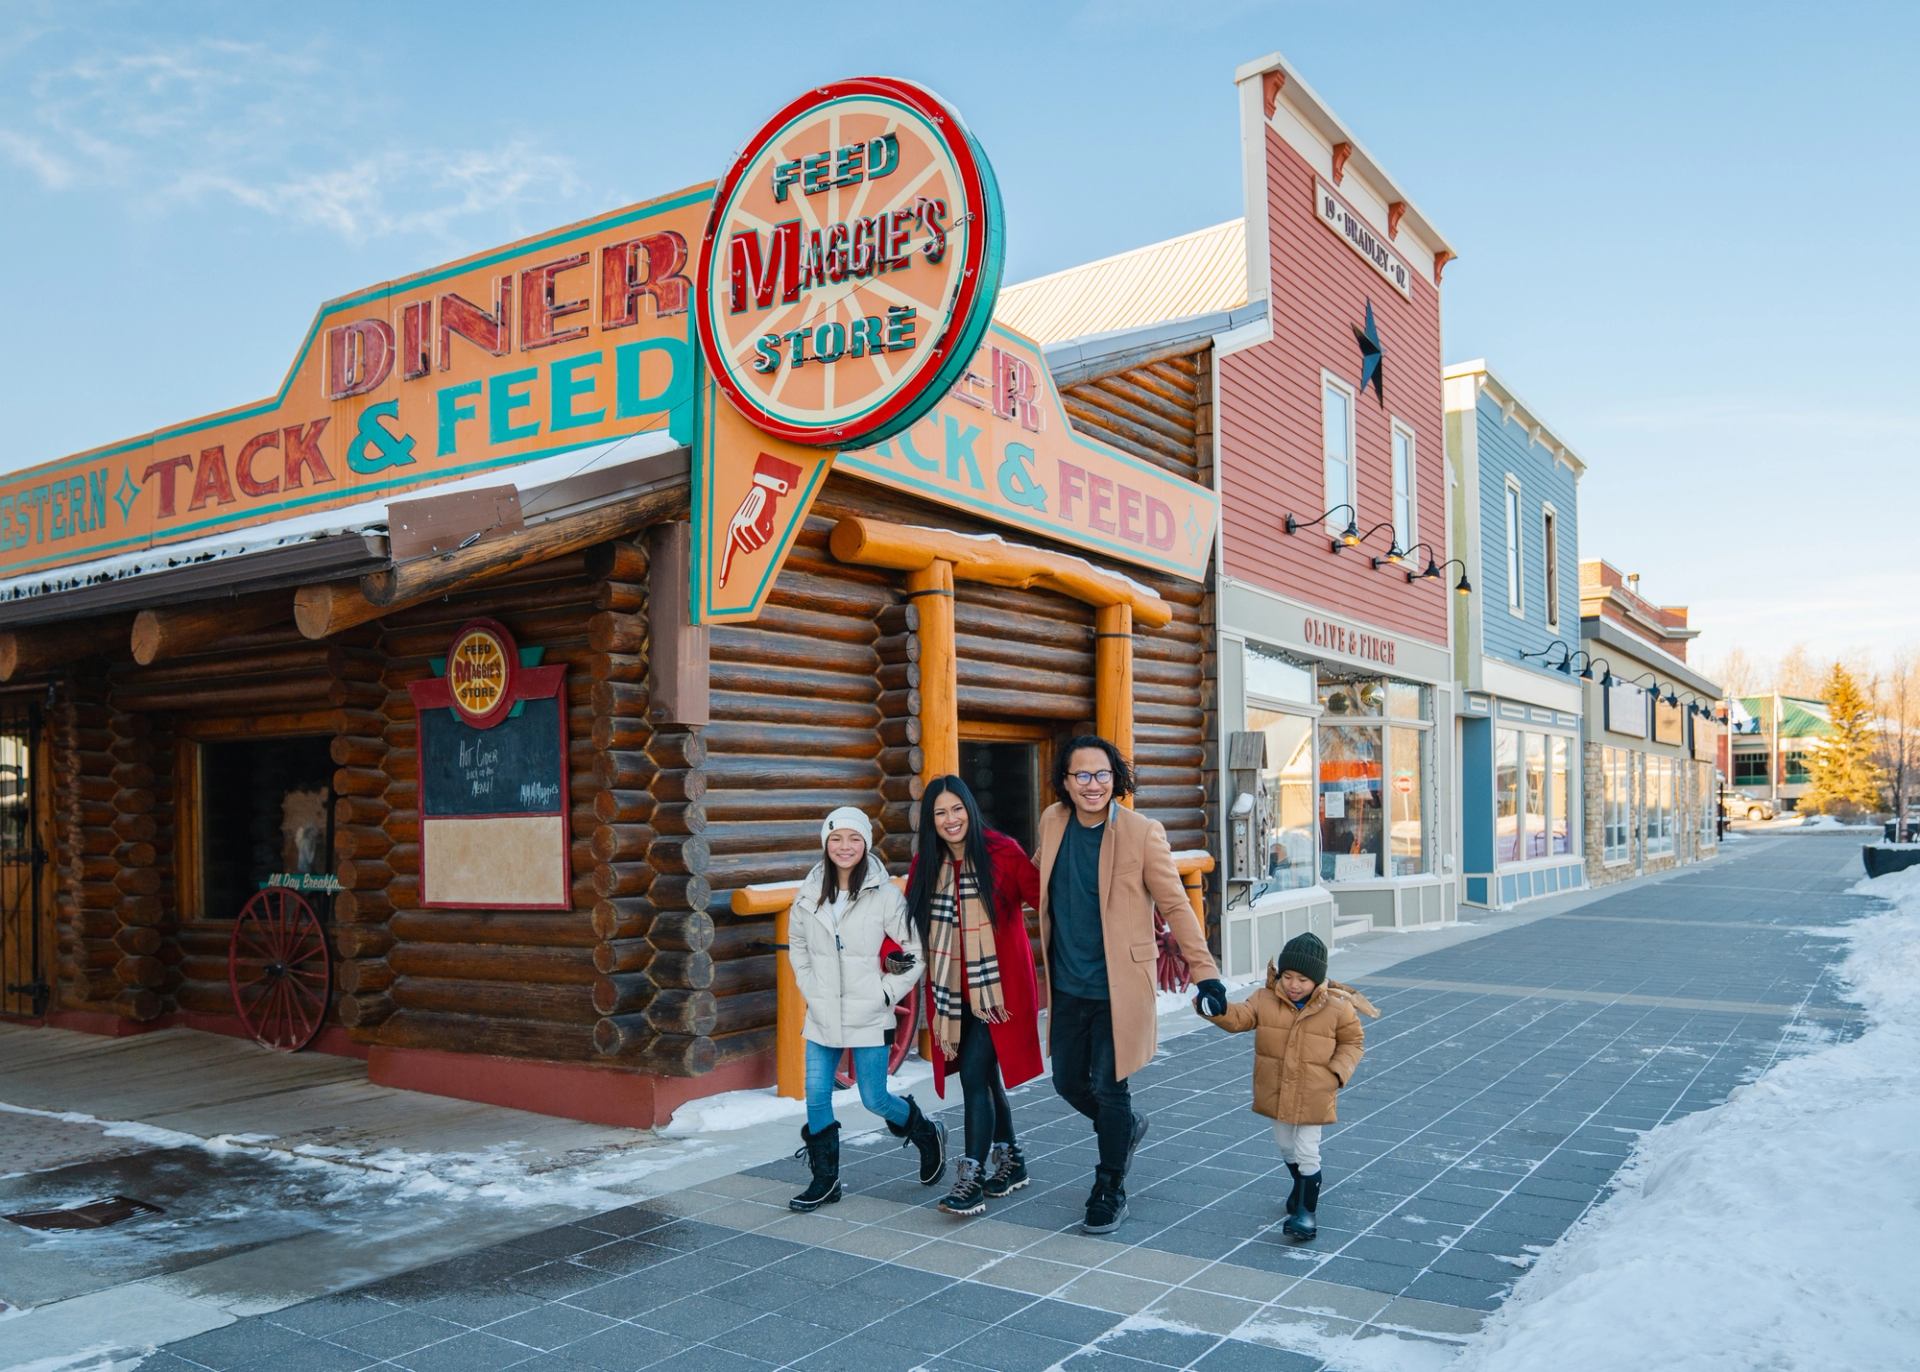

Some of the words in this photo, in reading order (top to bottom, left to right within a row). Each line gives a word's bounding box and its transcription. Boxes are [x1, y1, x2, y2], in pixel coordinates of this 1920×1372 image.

[773, 132, 900, 203] FEED
[729, 195, 948, 315] MAGGIE'S
[1344, 212, 1389, 272] BRADLEY
[322, 230, 692, 401] DINER
[753, 306, 917, 374] STORE
[142, 417, 336, 518] TACK
[346, 399, 417, 474] &
[436, 337, 690, 457] FEED
[997, 442, 1048, 513] &
[1058, 459, 1177, 552] FEED
[464, 644, 491, 656] FEED
[1304, 617, 1346, 653] OLIVE
[1349, 630, 1357, 656] &
[1360, 633, 1396, 666] FINCH
[461, 687, 495, 698] STORE
[268, 872, 281, 887] All
[283, 873, 300, 891] Day
